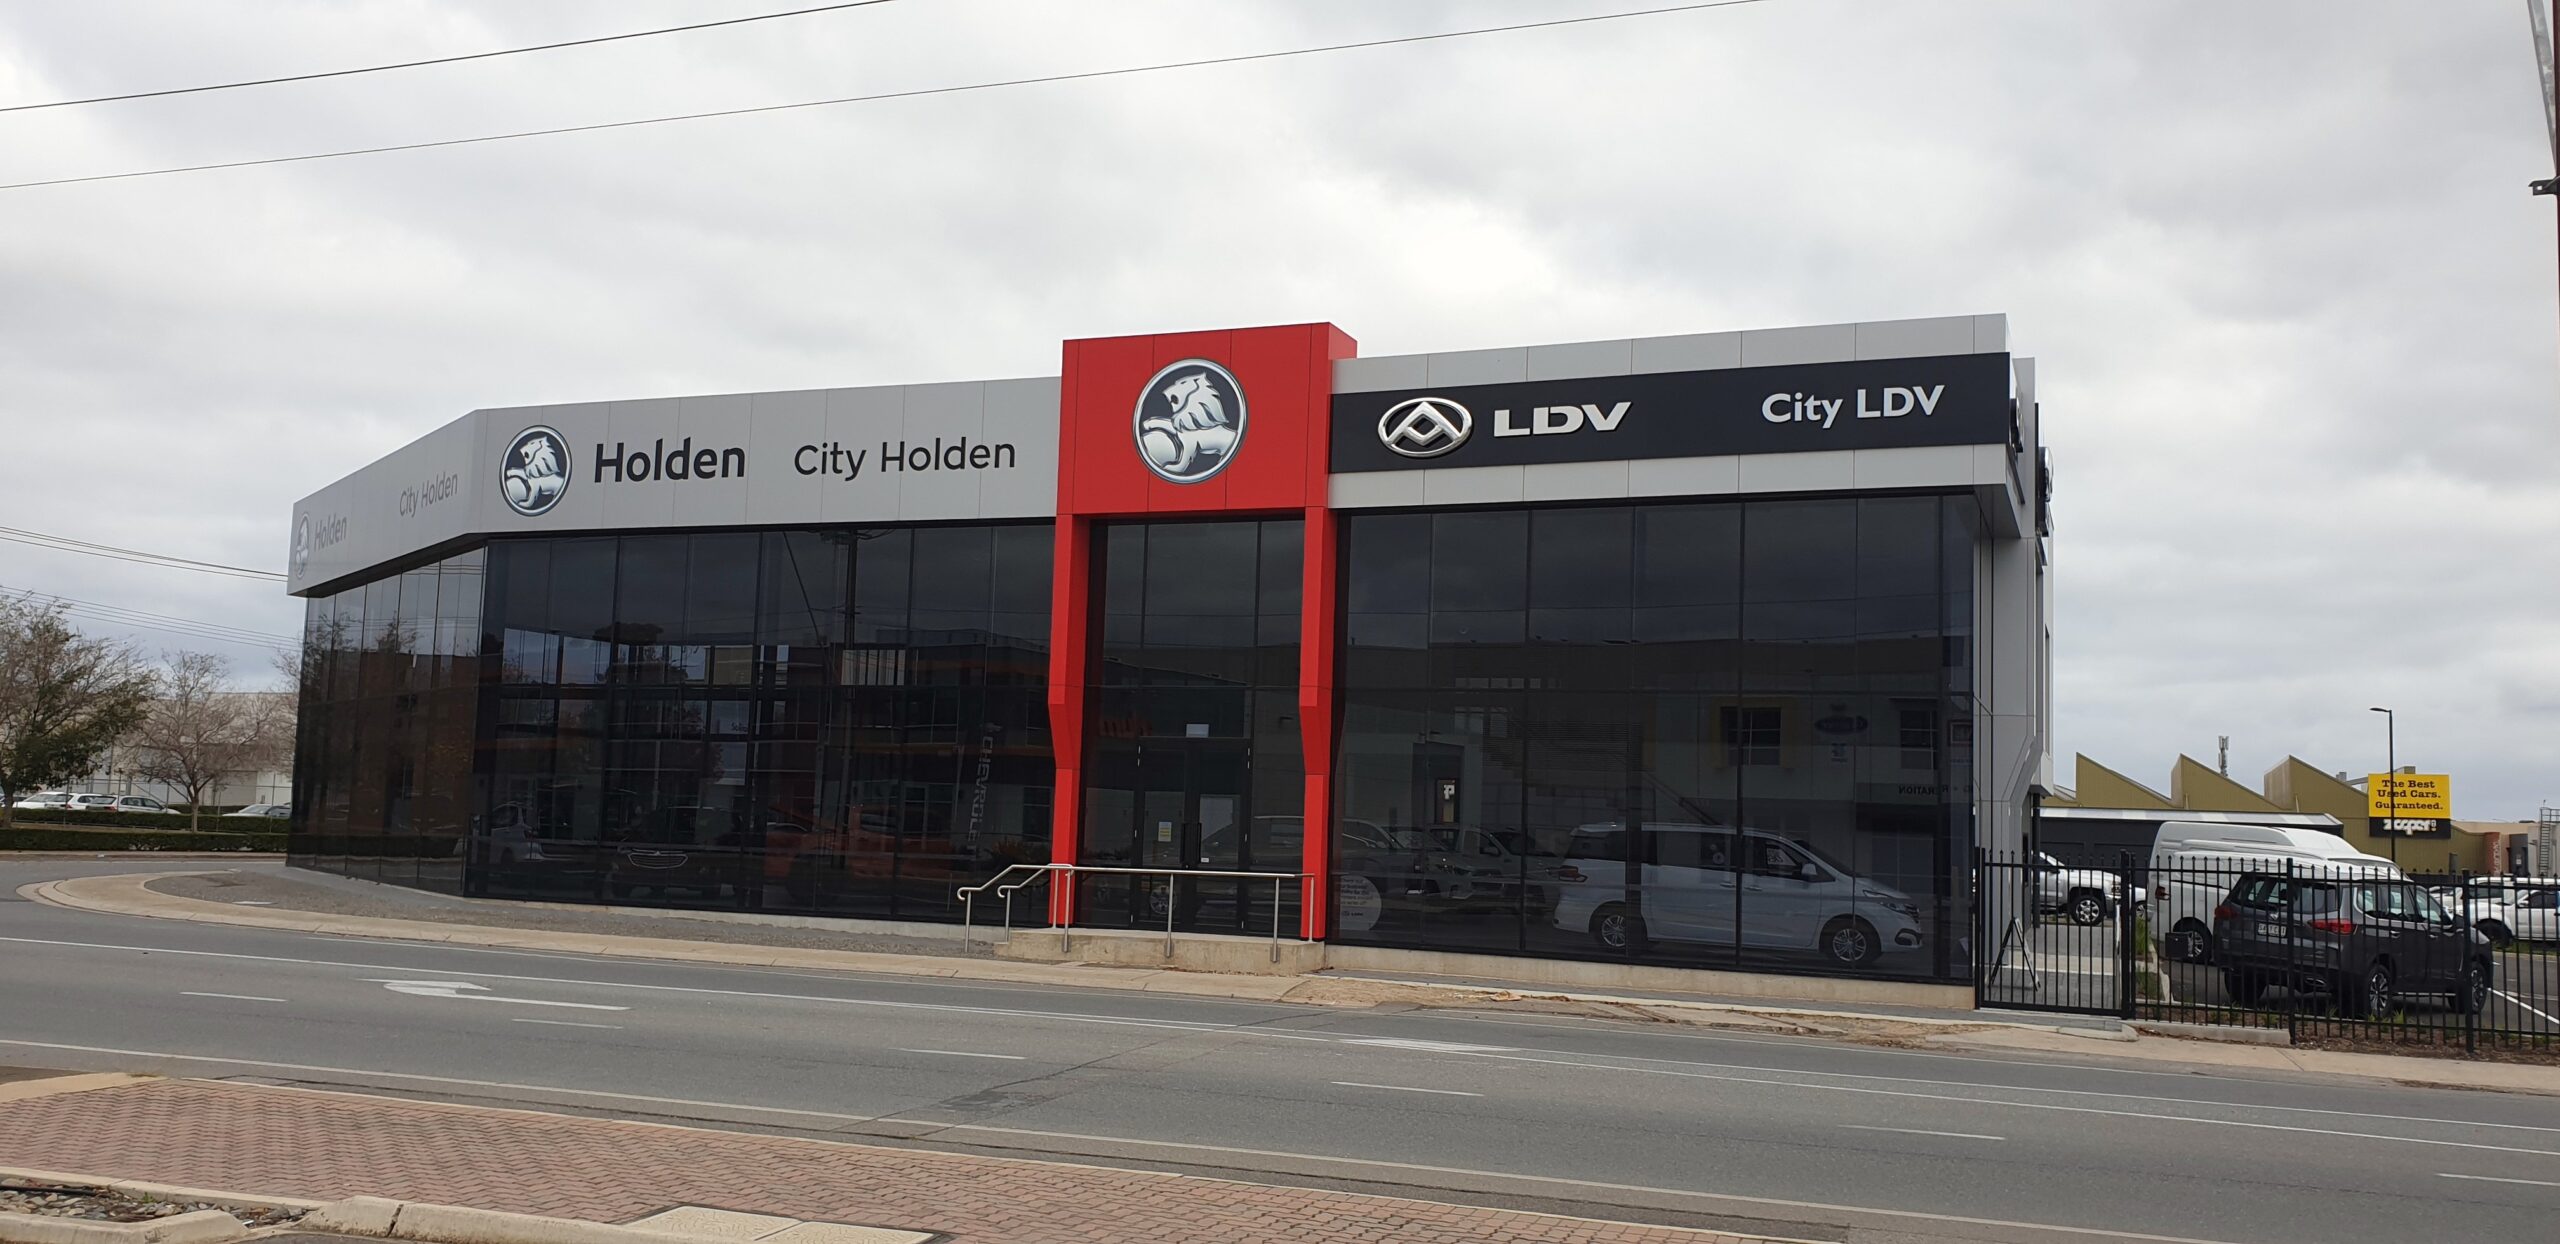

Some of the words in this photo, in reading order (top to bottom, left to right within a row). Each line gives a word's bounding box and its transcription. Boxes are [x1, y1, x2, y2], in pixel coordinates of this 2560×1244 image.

[1494, 401, 1632, 437] LDV
[1761, 391, 1843, 430] City
[1855, 384, 1946, 420] LDV
[593, 436, 746, 484] Holden
[794, 442, 867, 482] City
[881, 436, 1016, 473] Holden
[398, 485, 420, 518] City
[421, 470, 459, 508] Holden
[313, 512, 348, 552] Holden
[2376, 790, 2406, 798] Used
[2410, 790, 2442, 798] Cars.
[2381, 780, 2405, 788] The
[2408, 780, 2436, 788] Best
